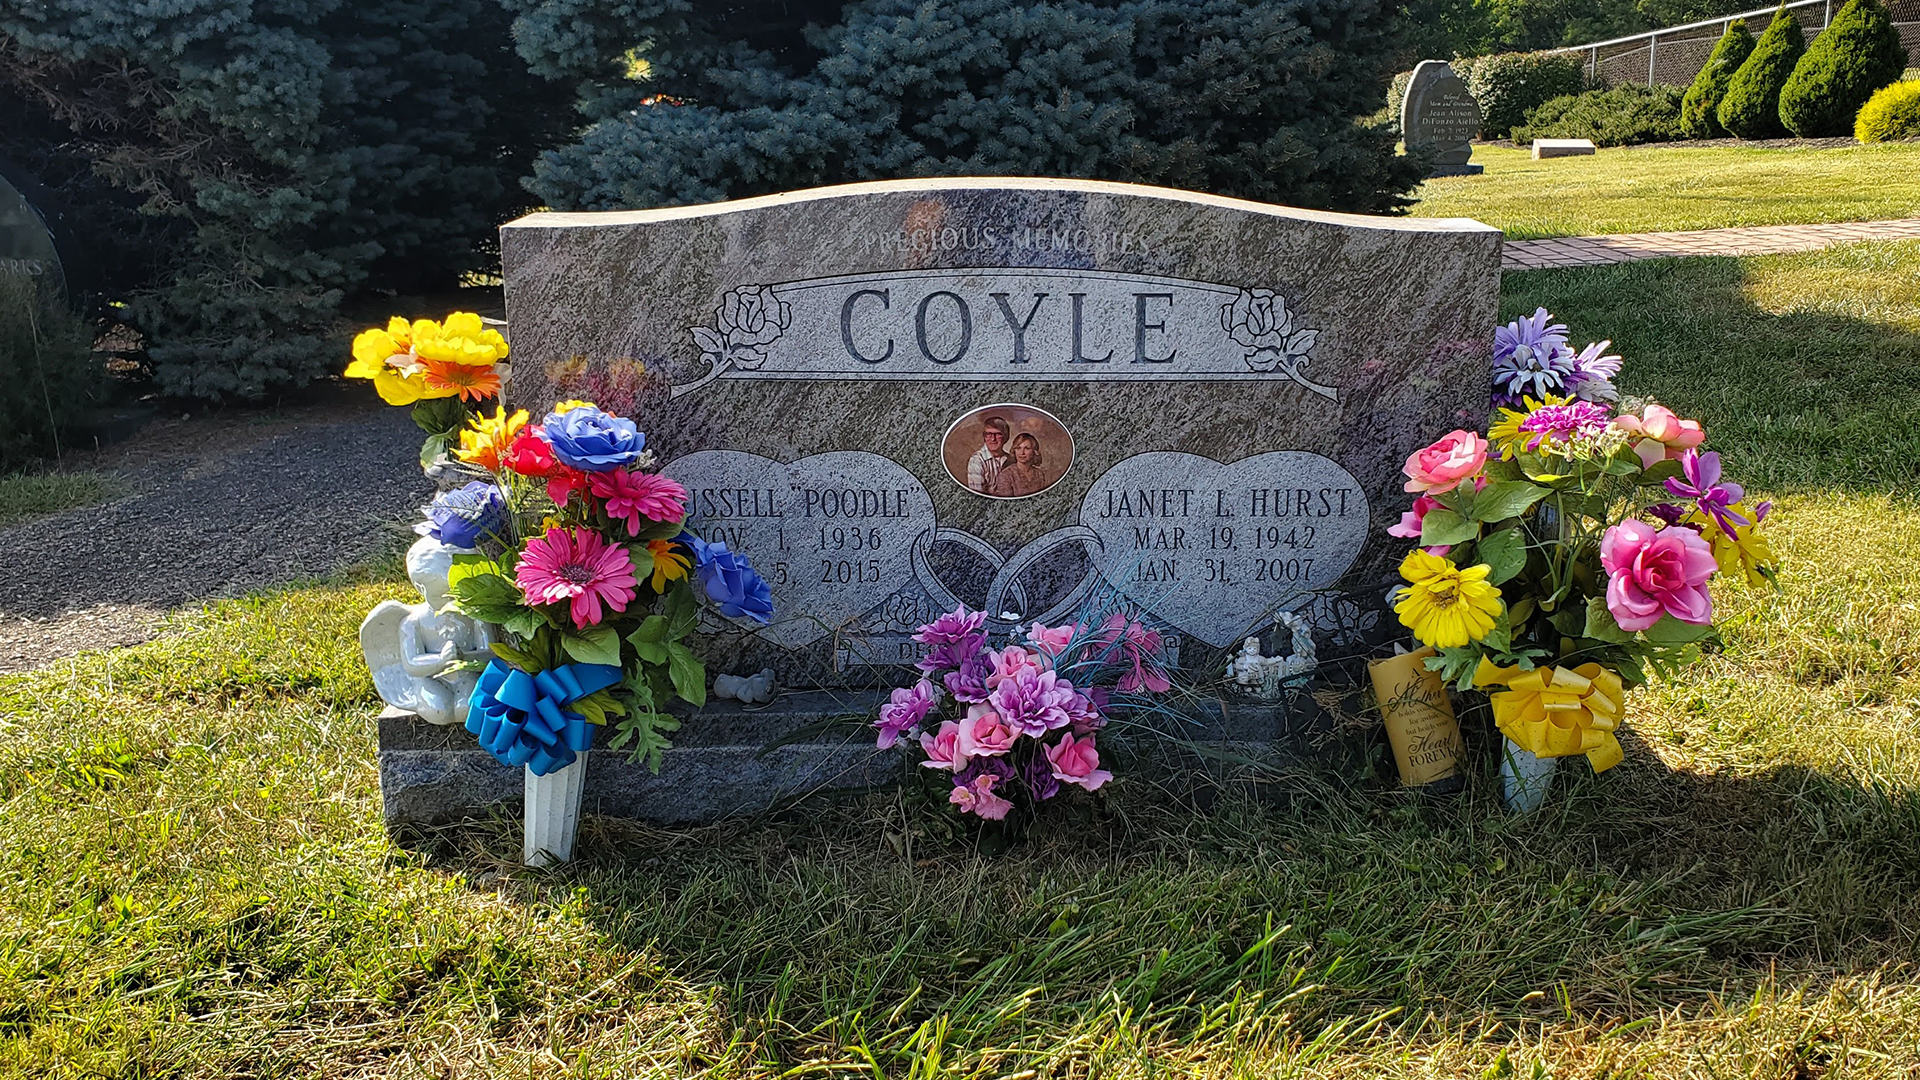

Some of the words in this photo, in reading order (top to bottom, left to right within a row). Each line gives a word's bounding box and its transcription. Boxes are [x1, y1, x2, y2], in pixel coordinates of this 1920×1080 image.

[1422, 117, 1454, 125] DiFonzo
[1456, 117, 1479, 125] Aiello
[1429, 109, 1446, 117] Jean
[1449, 109, 1472, 117] Alison
[862, 226, 996, 256] PRECIOUS
[1011, 226, 1149, 257] MEMORIES
[839, 287, 1177, 365] COYLE
[1100, 488, 1195, 519] JANET
[1215, 489, 1235, 518] L.
[1249, 487, 1353, 519] HURST
[777, 527, 791, 552] 1,
[820, 527, 882, 551] 1936
[1133, 527, 1193, 550] MAR.
[1210, 526, 1238, 552] 19,
[1255, 526, 1316, 549] 1942
[821, 559, 881, 584] 2015
[1130, 559, 1181, 582] JAN.
[1204, 559, 1233, 585] 31,
[1254, 559, 1316, 582] 2007
[1387, 677, 1442, 714] Mother
[1405, 728, 1417, 736] but
[1417, 723, 1436, 733] holds
[1408, 717, 1419, 725] for
[1408, 730, 1453, 755] Heart
